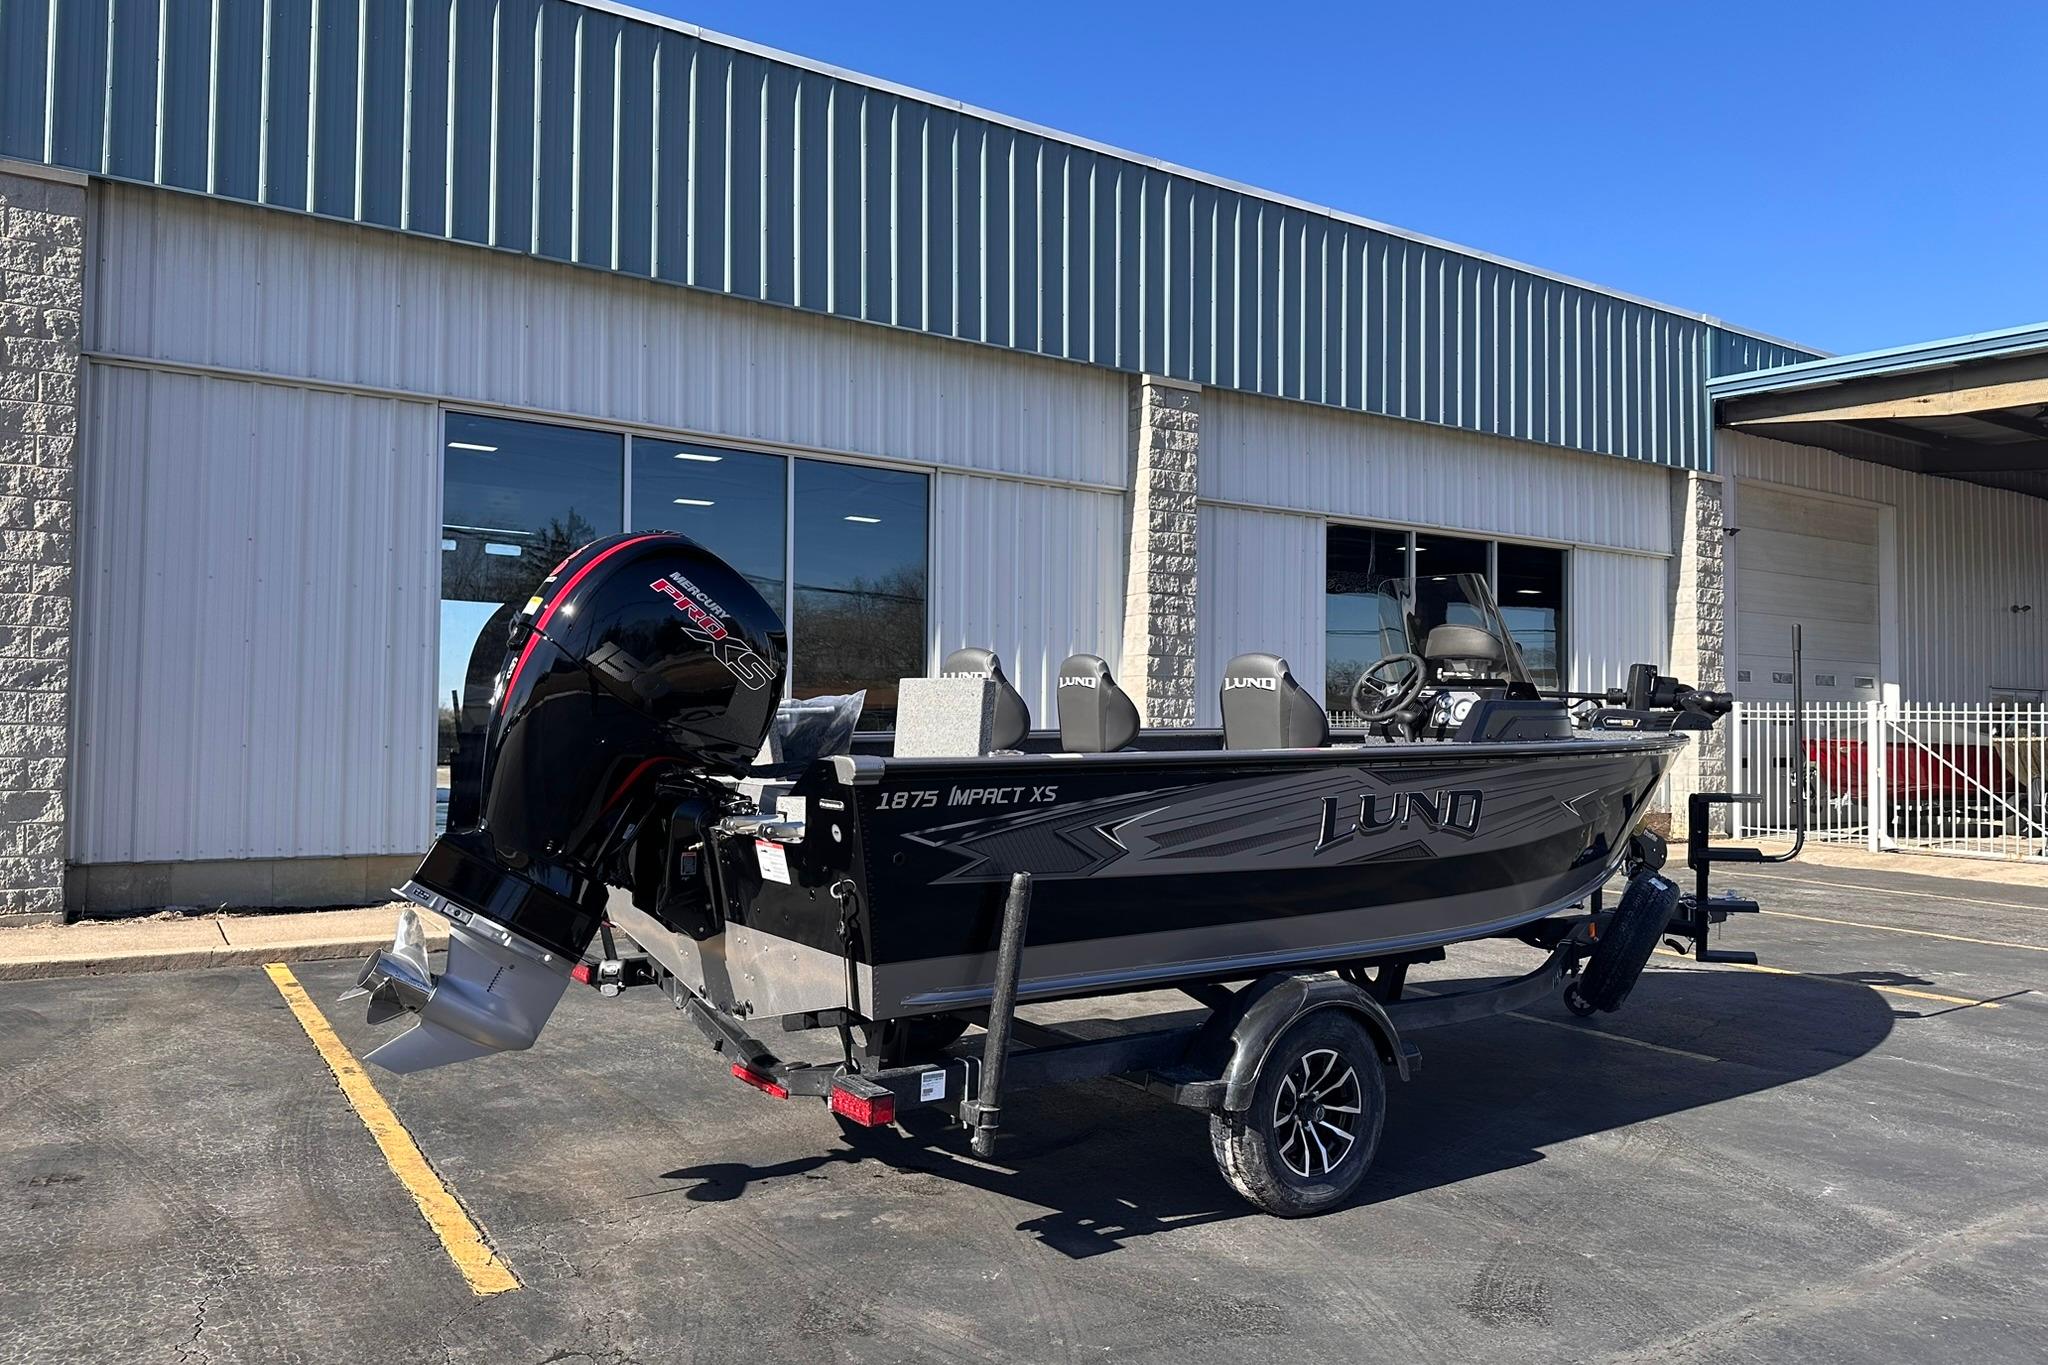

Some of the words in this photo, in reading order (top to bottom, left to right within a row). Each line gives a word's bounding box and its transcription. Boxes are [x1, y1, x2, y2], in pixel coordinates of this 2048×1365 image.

[650, 578, 728, 641] PRO
[669, 571, 732, 620] MERCURY
[681, 626, 776, 691] XS
[1059, 676, 1096, 690] LUND
[1224, 677, 1276, 691] LUND
[875, 791, 939, 810] 1875
[947, 785, 1026, 806] IMPACT
[1029, 785, 1060, 803] XS
[1313, 788, 1485, 855] LUND
